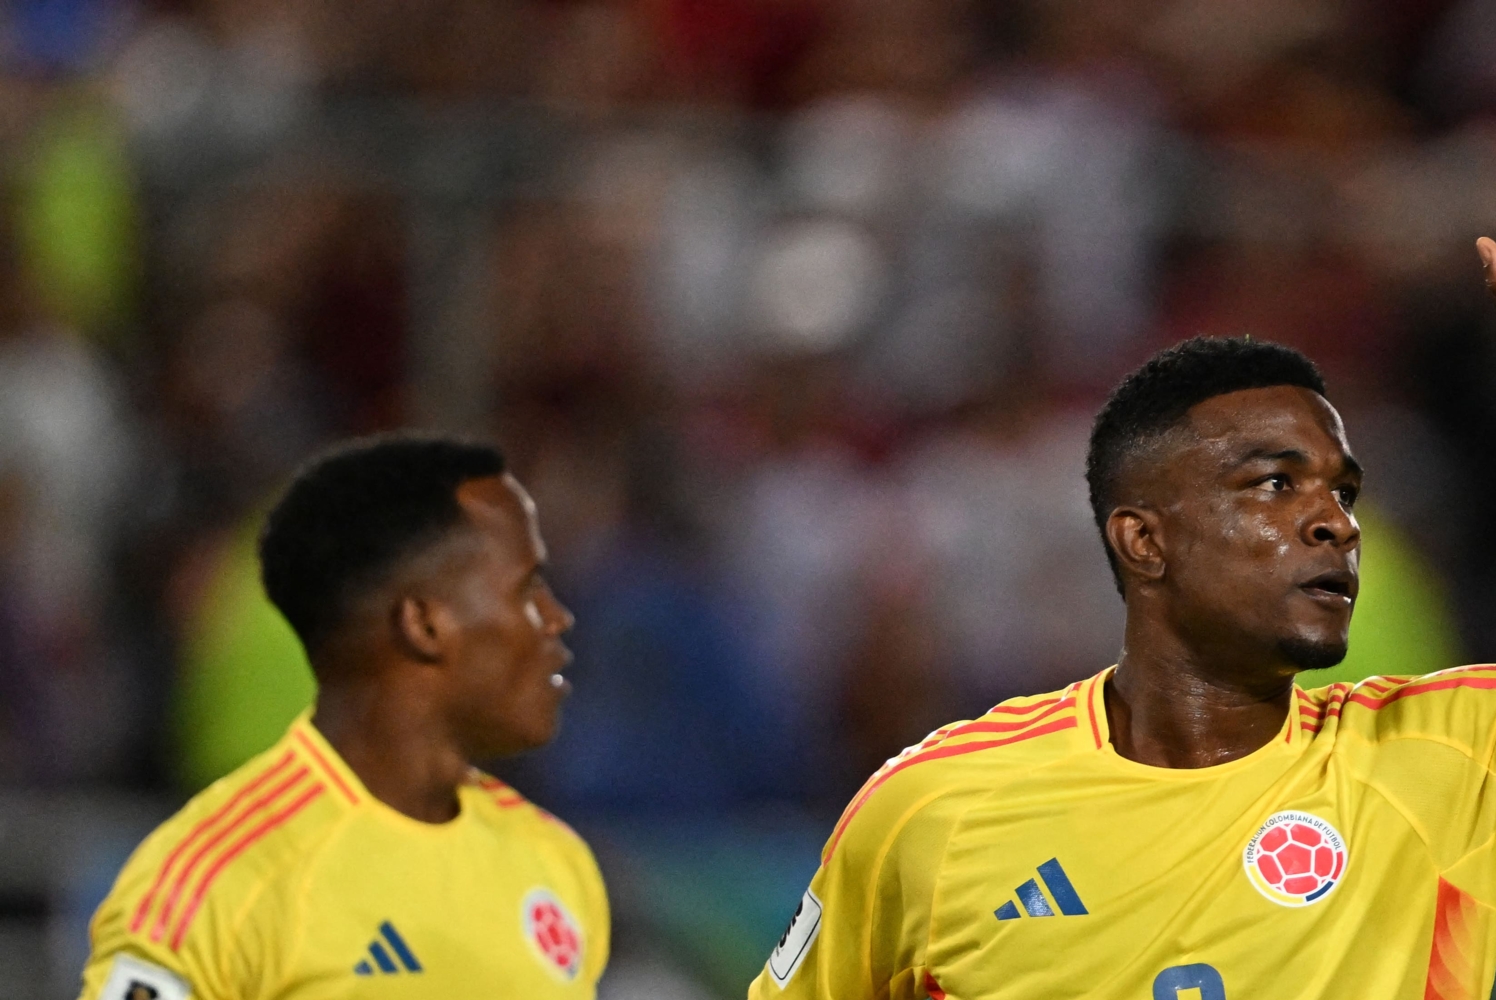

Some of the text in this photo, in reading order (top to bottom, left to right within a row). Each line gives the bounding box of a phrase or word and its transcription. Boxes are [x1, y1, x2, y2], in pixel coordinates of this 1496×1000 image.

[1265, 813, 1313, 828] COLOMBIANA
[1313, 820, 1324, 829] DE
[1321, 826, 1342, 850] FUTBOL
